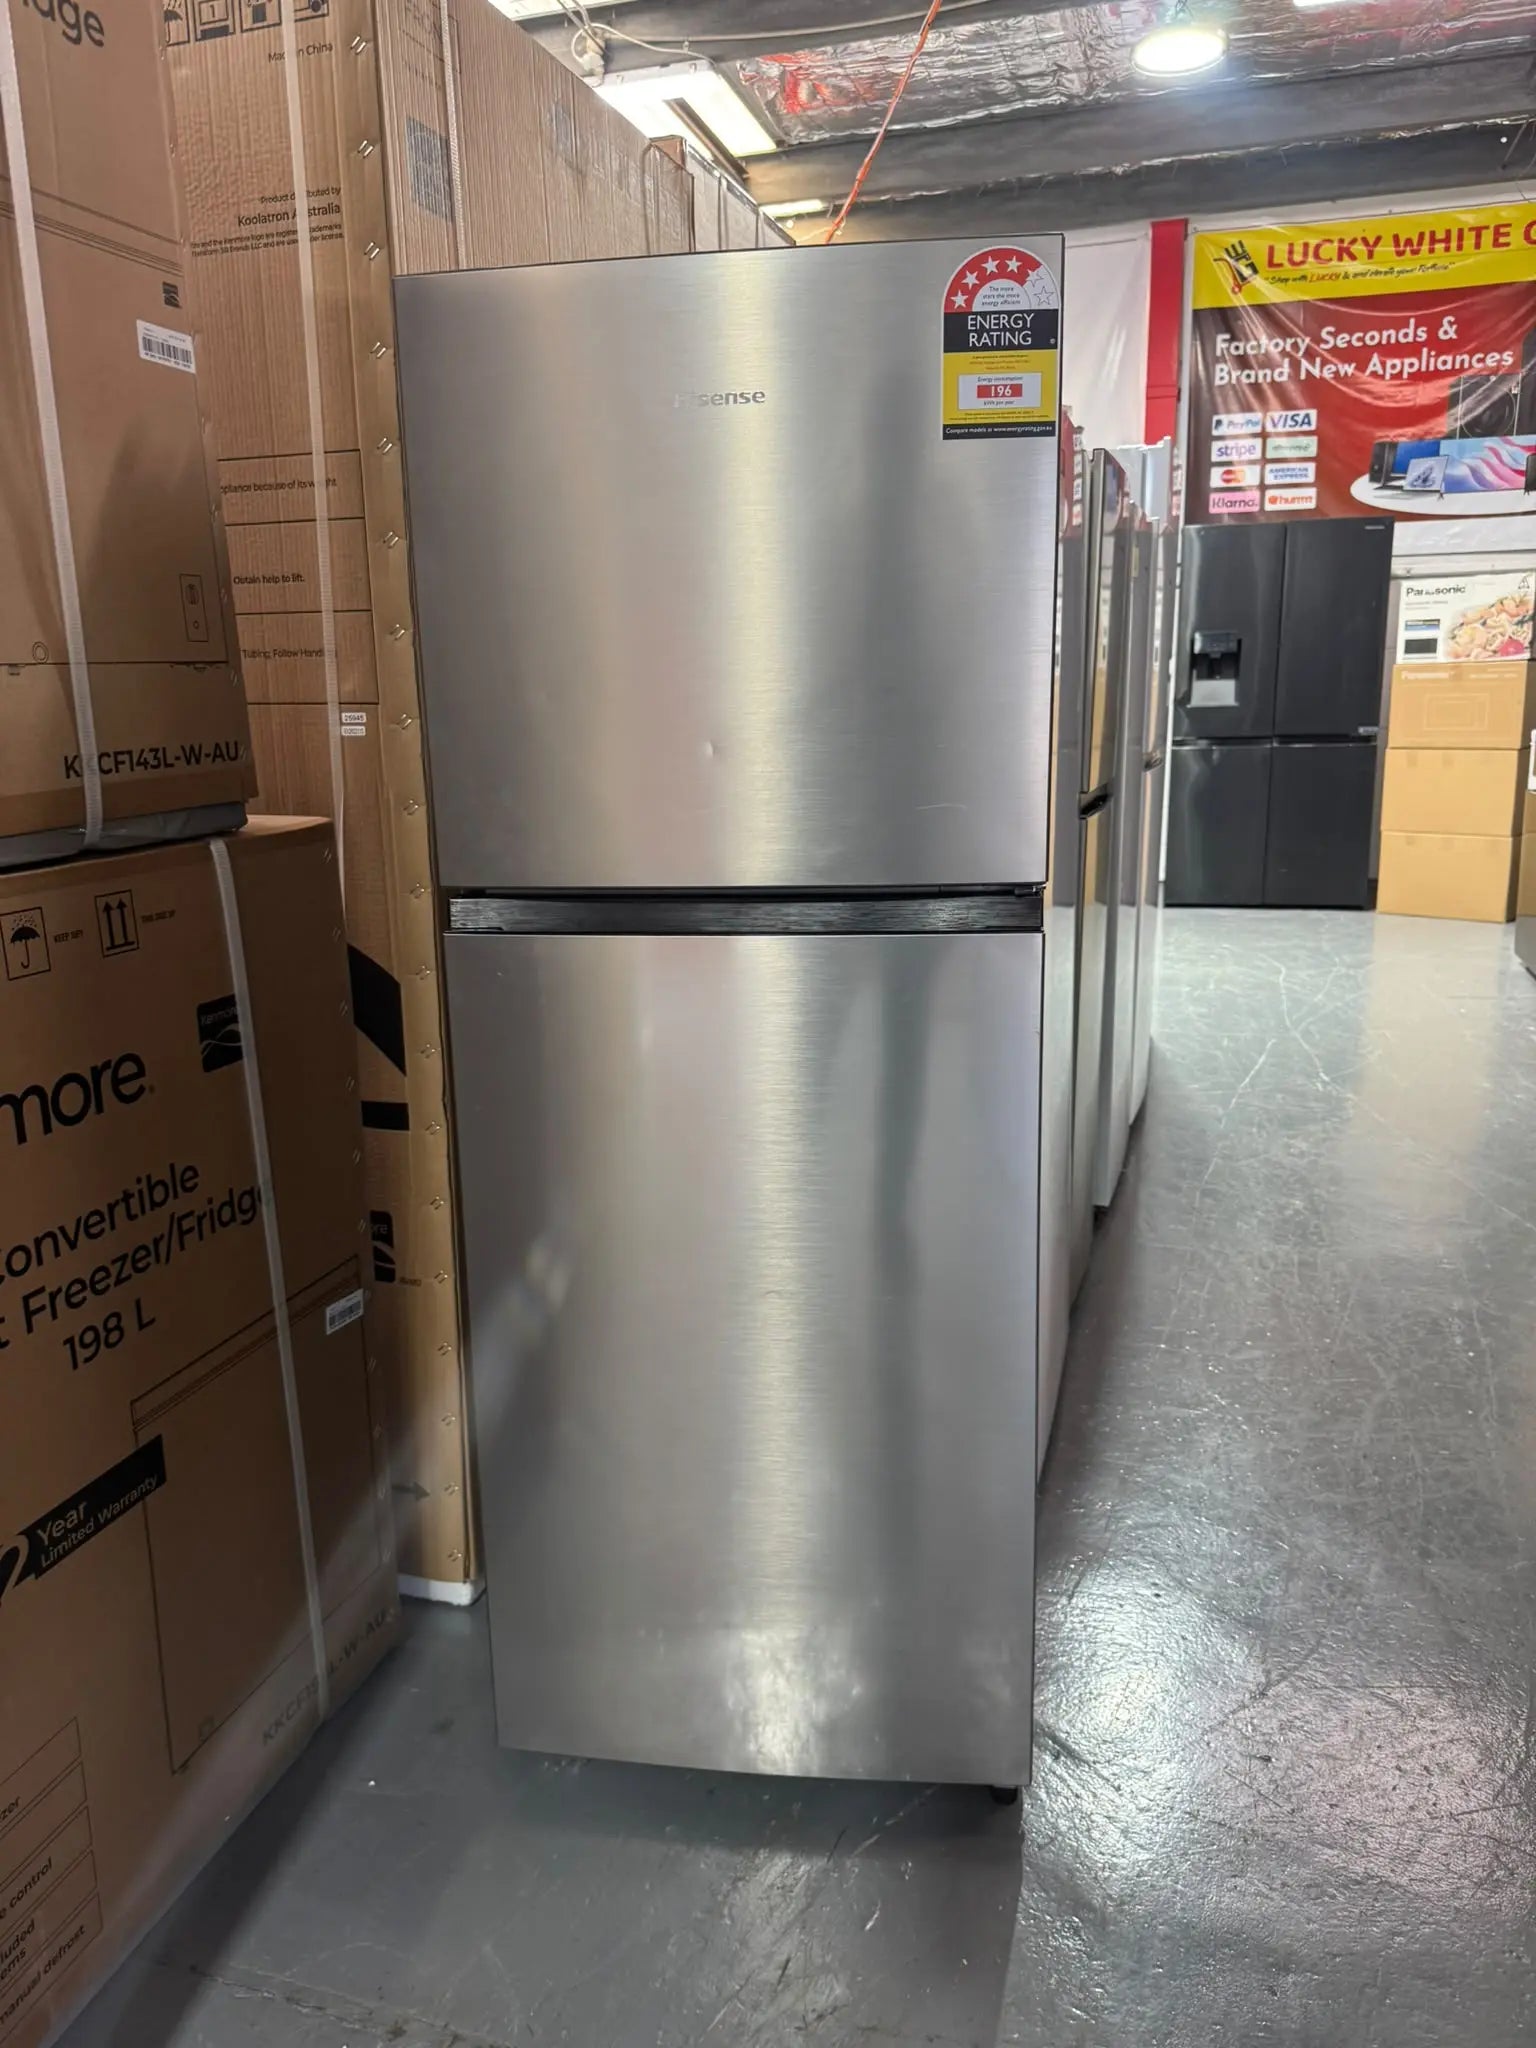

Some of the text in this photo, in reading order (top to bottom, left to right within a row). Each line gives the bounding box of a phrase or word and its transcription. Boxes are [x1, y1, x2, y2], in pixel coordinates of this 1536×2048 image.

[306, 42, 334, 56] China
[260, 193, 288, 204] Product
[331, 187, 342, 198] by
[238, 202, 341, 228] Koolatron Astralia
[1266, 234, 1382, 270] LUCKY
[1392, 223, 1513, 257] WHITE
[1291, 274, 1308, 283] with
[968, 313, 1035, 331] ENERGY
[969, 331, 1032, 348] RATING
[1215, 315, 1458, 357] Factory Seconds &
[1214, 347, 1514, 387] Brand New Appliances
[991, 384, 1012, 397] 196
[1227, 418, 1260, 430] PayPal
[1270, 412, 1313, 429] VISA
[946, 427, 968, 435] Compare
[1216, 443, 1256, 459] stripe
[253, 482, 287, 492] because
[287, 480, 296, 490] of
[233, 575, 261, 585] Obtain
[262, 574, 281, 585] help
[281, 574, 291, 583] to
[273, 648, 298, 658] Follow
[63, 740, 239, 779] KCF143L-W-AU
[54, 931, 69, 943] KEEP
[0, 1163, 200, 1285] onvertible
[62, 1311, 125, 1371] 198
[134, 1298, 156, 1332] L
[37, 1502, 88, 1547] Year
[40, 1474, 158, 1568] Limited Warranty
[9, 1855, 53, 1910] control
[43, 1923, 87, 1976] defrost
